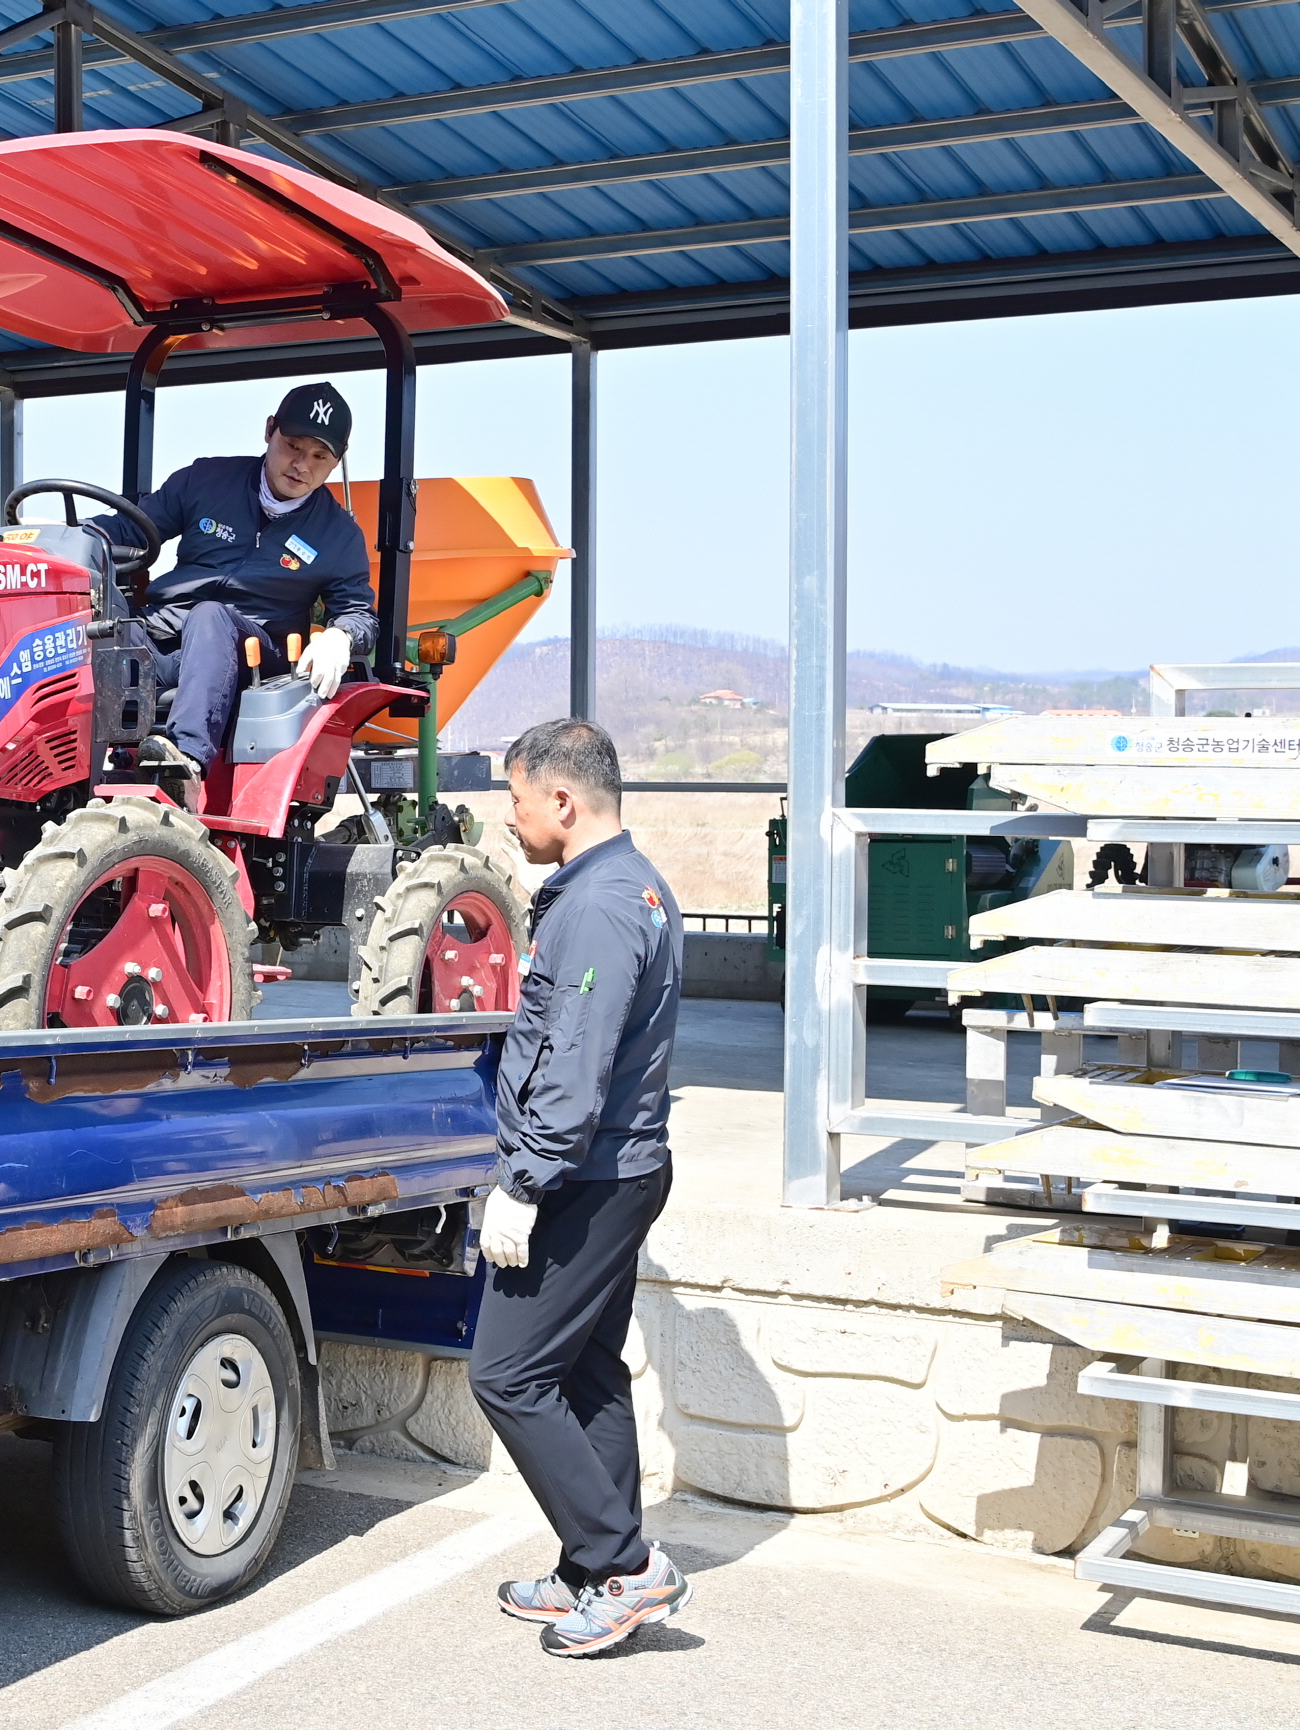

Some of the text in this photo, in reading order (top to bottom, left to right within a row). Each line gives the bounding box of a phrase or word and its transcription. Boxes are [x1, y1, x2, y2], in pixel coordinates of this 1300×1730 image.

[309, 398, 334, 426] NY
[32, 624, 88, 661] 승용관리기
[1166, 737, 1300, 754] 청송군농업기술센터
